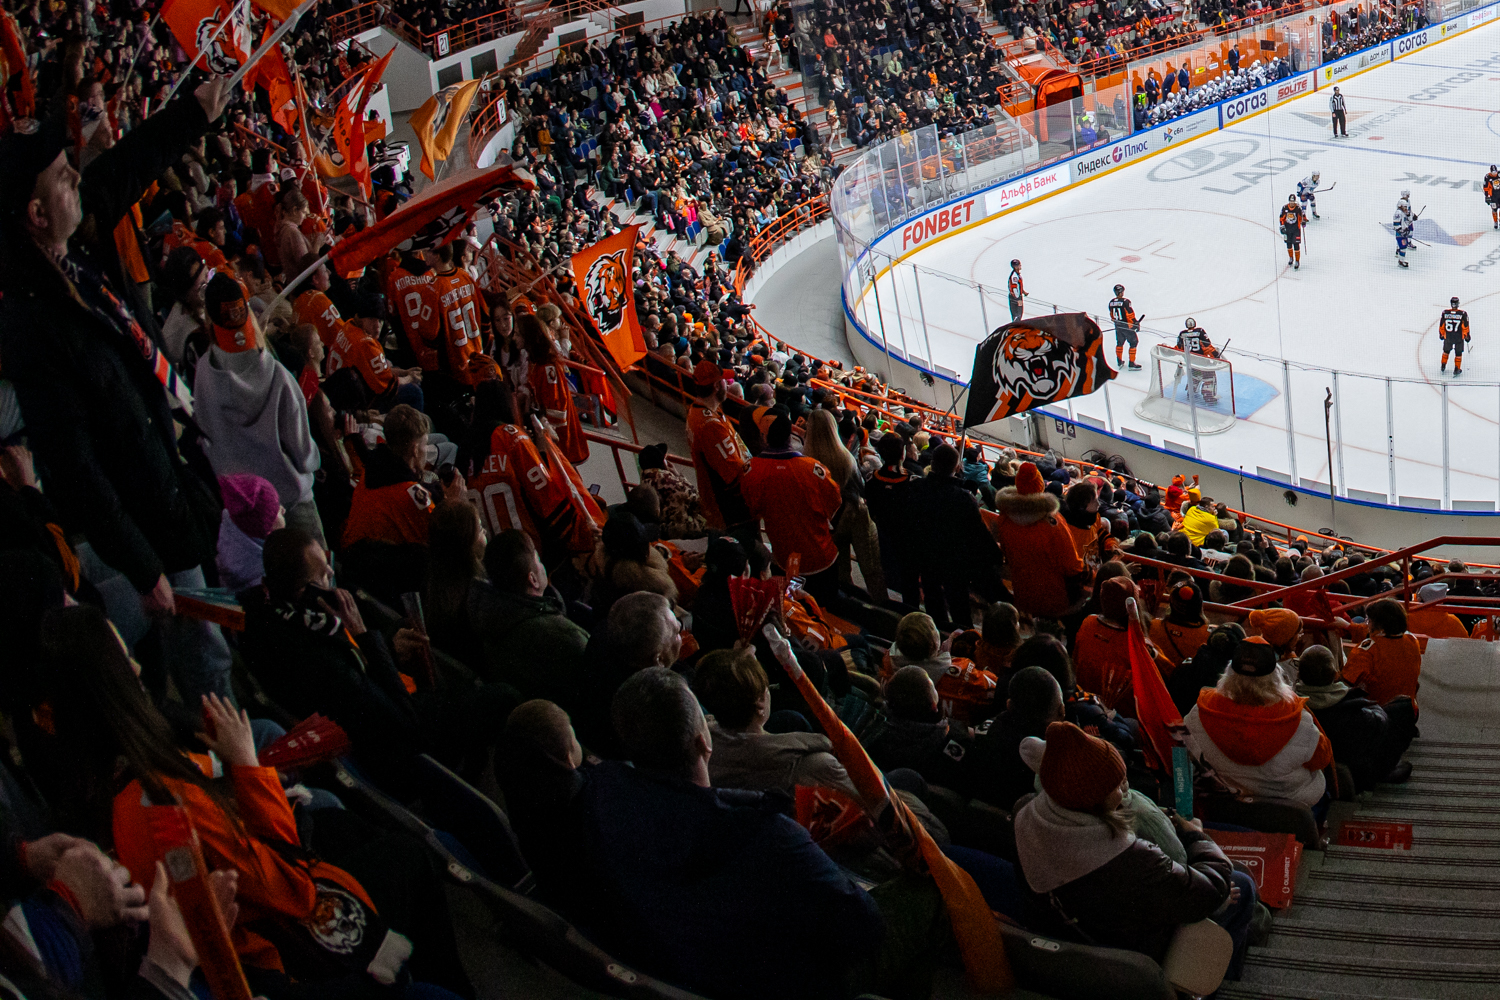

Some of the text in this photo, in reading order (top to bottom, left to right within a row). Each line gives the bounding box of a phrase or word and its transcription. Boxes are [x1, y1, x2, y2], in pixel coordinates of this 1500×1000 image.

[439, 35, 448, 52] 21
[1369, 48, 1389, 62] ДОМ АРТ
[1333, 63, 1348, 75] БАНК
[1277, 79, 1308, 98] SOLITE
[1077, 140, 1148, 177] Яндекс Плюс
[1200, 149, 1328, 195] LADA
[1000, 172, 1058, 203] Альфа Банк
[903, 200, 975, 251] FONBET
[320, 304, 341, 328] 30
[448, 300, 481, 347] 50
[1445, 319, 1462, 332] 67
[1056, 419, 1063, 430] 5
[477, 454, 508, 476] LEV
